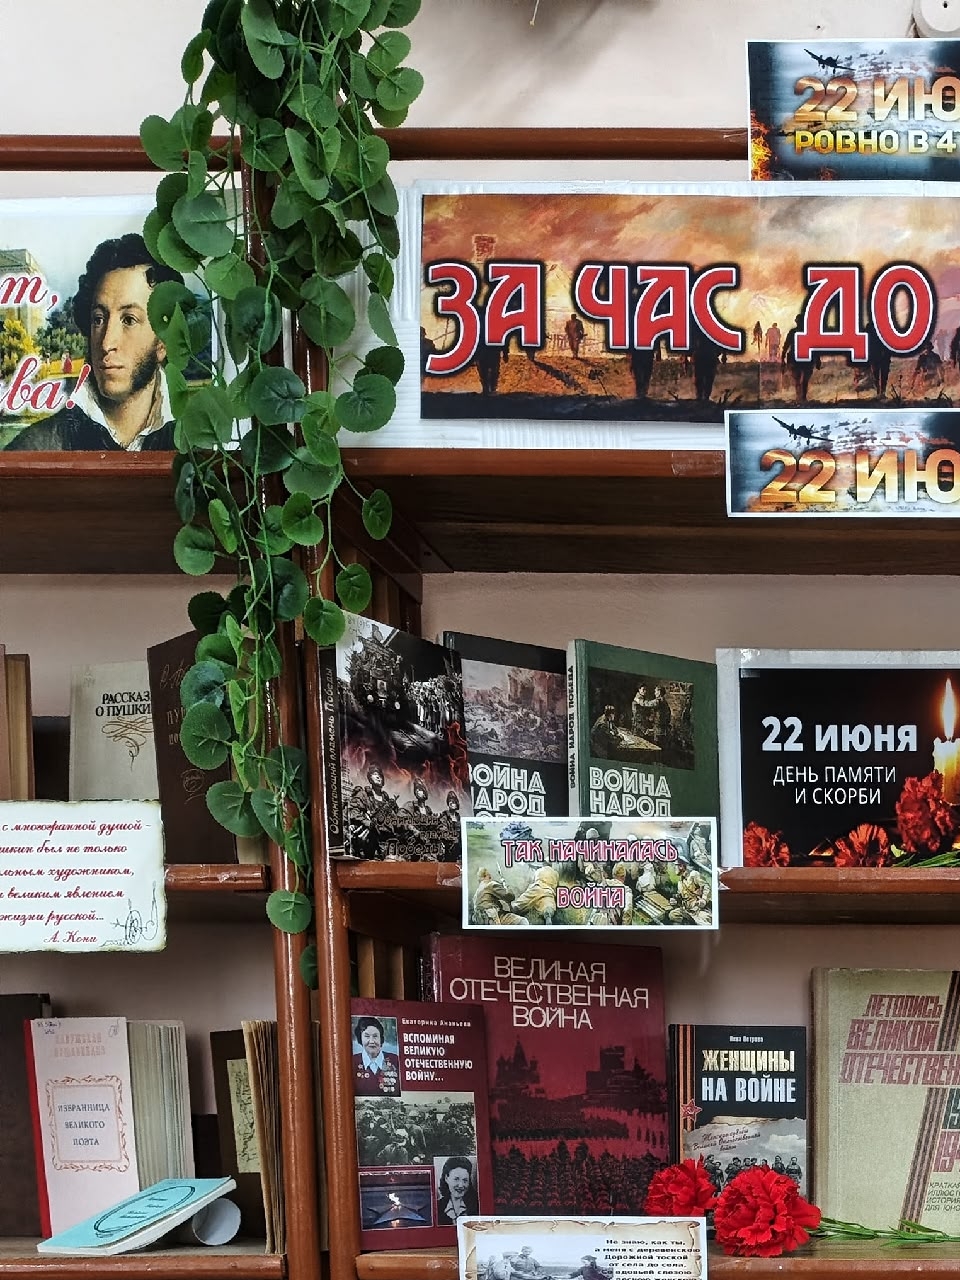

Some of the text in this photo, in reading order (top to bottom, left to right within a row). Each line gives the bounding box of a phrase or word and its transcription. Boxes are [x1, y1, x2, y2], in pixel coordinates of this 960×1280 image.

[793, 76, 858, 122] 22
[794, 129, 899, 153] РОВНО
[908, 129, 929, 153] В
[936, 129, 956, 153] 4
[426, 263, 545, 374] ЗА
[576, 265, 743, 352] ЧАС
[796, 265, 934, 362] ДО
[759, 449, 837, 503] 22
[590, 766, 671, 798] ВОЙНА
[773, 766, 896, 786] ДЕНЬ ПАМЯТИ
[796, 788, 881, 805] И СКОРБИ
[502, 839, 677, 867] ТАК НАЧИНАЛАСЬ
[556, 882, 625, 908] ВОЙНА
[494, 957, 605, 983] ВЕЛИКАЯ
[449, 978, 649, 1008] ОТЕЧЕСТВЕННАЯ
[513, 1006, 593, 1029] ВОЙНА
[863, 995, 942, 1017] ЛЕТОПИСЬ
[403, 1033, 454, 1044] ВСПОМИНАЯ
[847, 1019, 940, 1051] ВЕЛИКОЙ
[404, 1046, 445, 1056] ВЕЛИКУЮ
[702, 1050, 795, 1075] ЖЕНЩИНЫ
[405, 1060, 473, 1069] ОТЕЧЕСТВЕННУЮ
[702, 1073, 796, 1102] НА ВОЙНЕ
[64, 1120, 105, 1129] ВЕЛИКОГО
